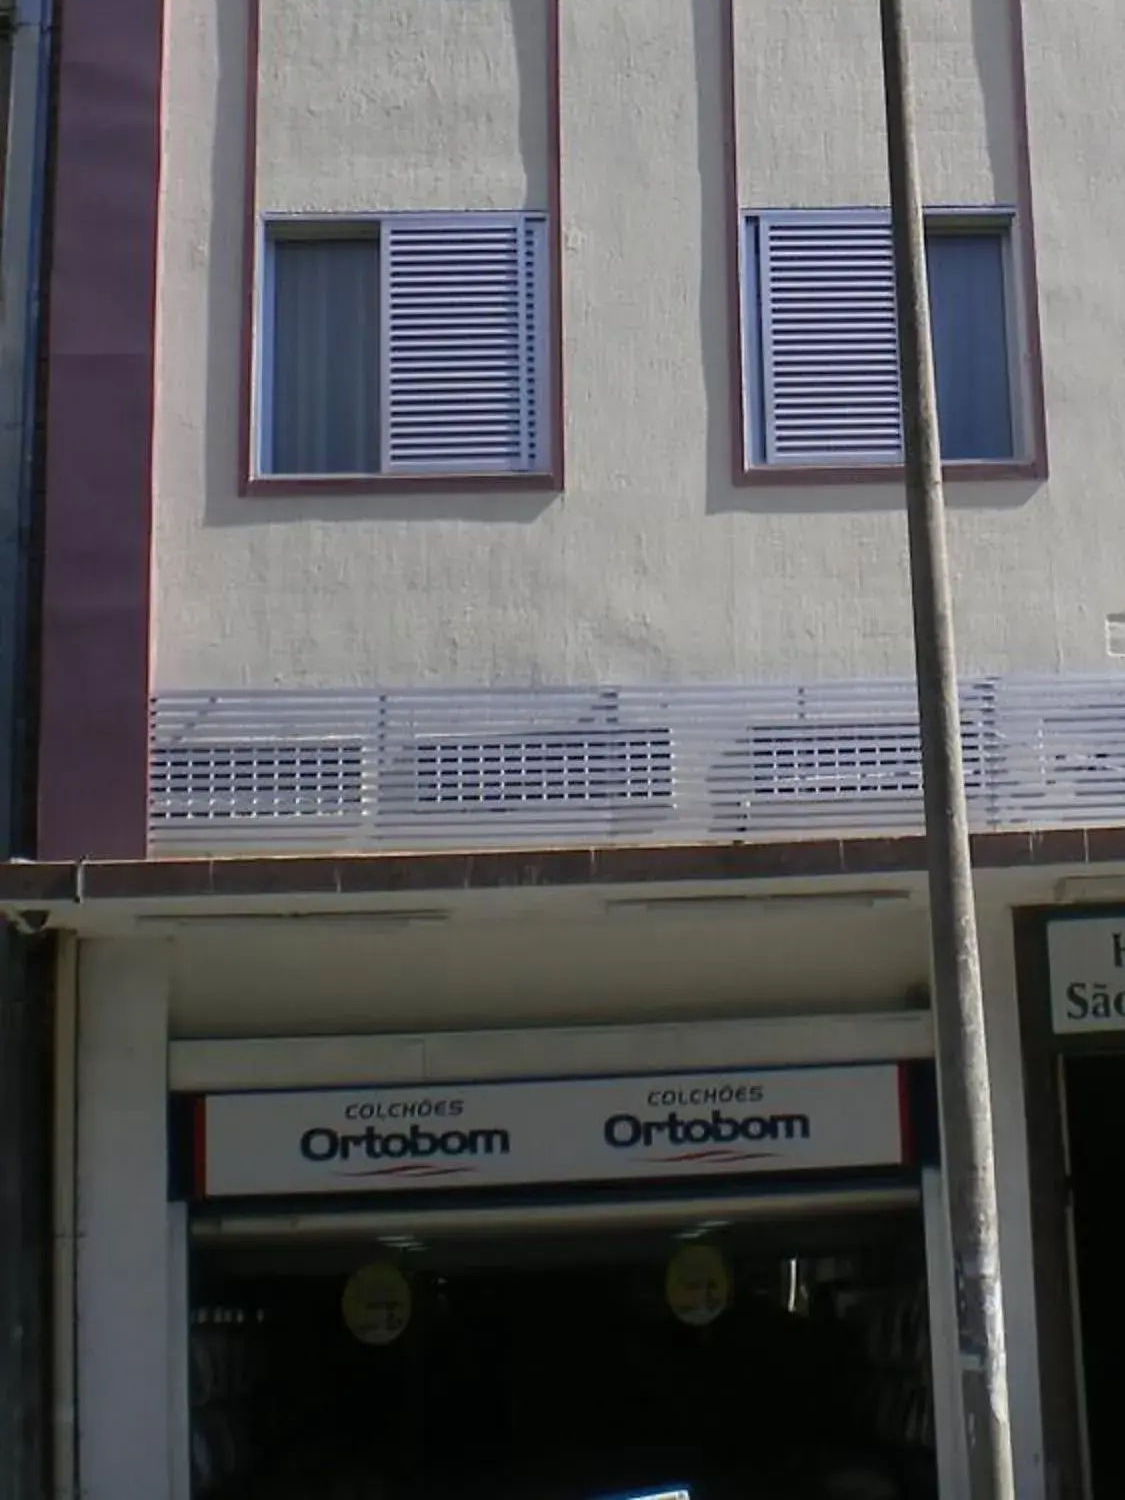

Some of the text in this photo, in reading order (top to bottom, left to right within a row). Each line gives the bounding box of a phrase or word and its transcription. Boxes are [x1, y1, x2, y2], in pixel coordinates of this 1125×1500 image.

[344, 1099, 464, 1120] COLCHÕES
[646, 1085, 764, 1106] COLCHÕES
[300, 1124, 510, 1162] Ortobom
[603, 1110, 809, 1148] Ortobom
